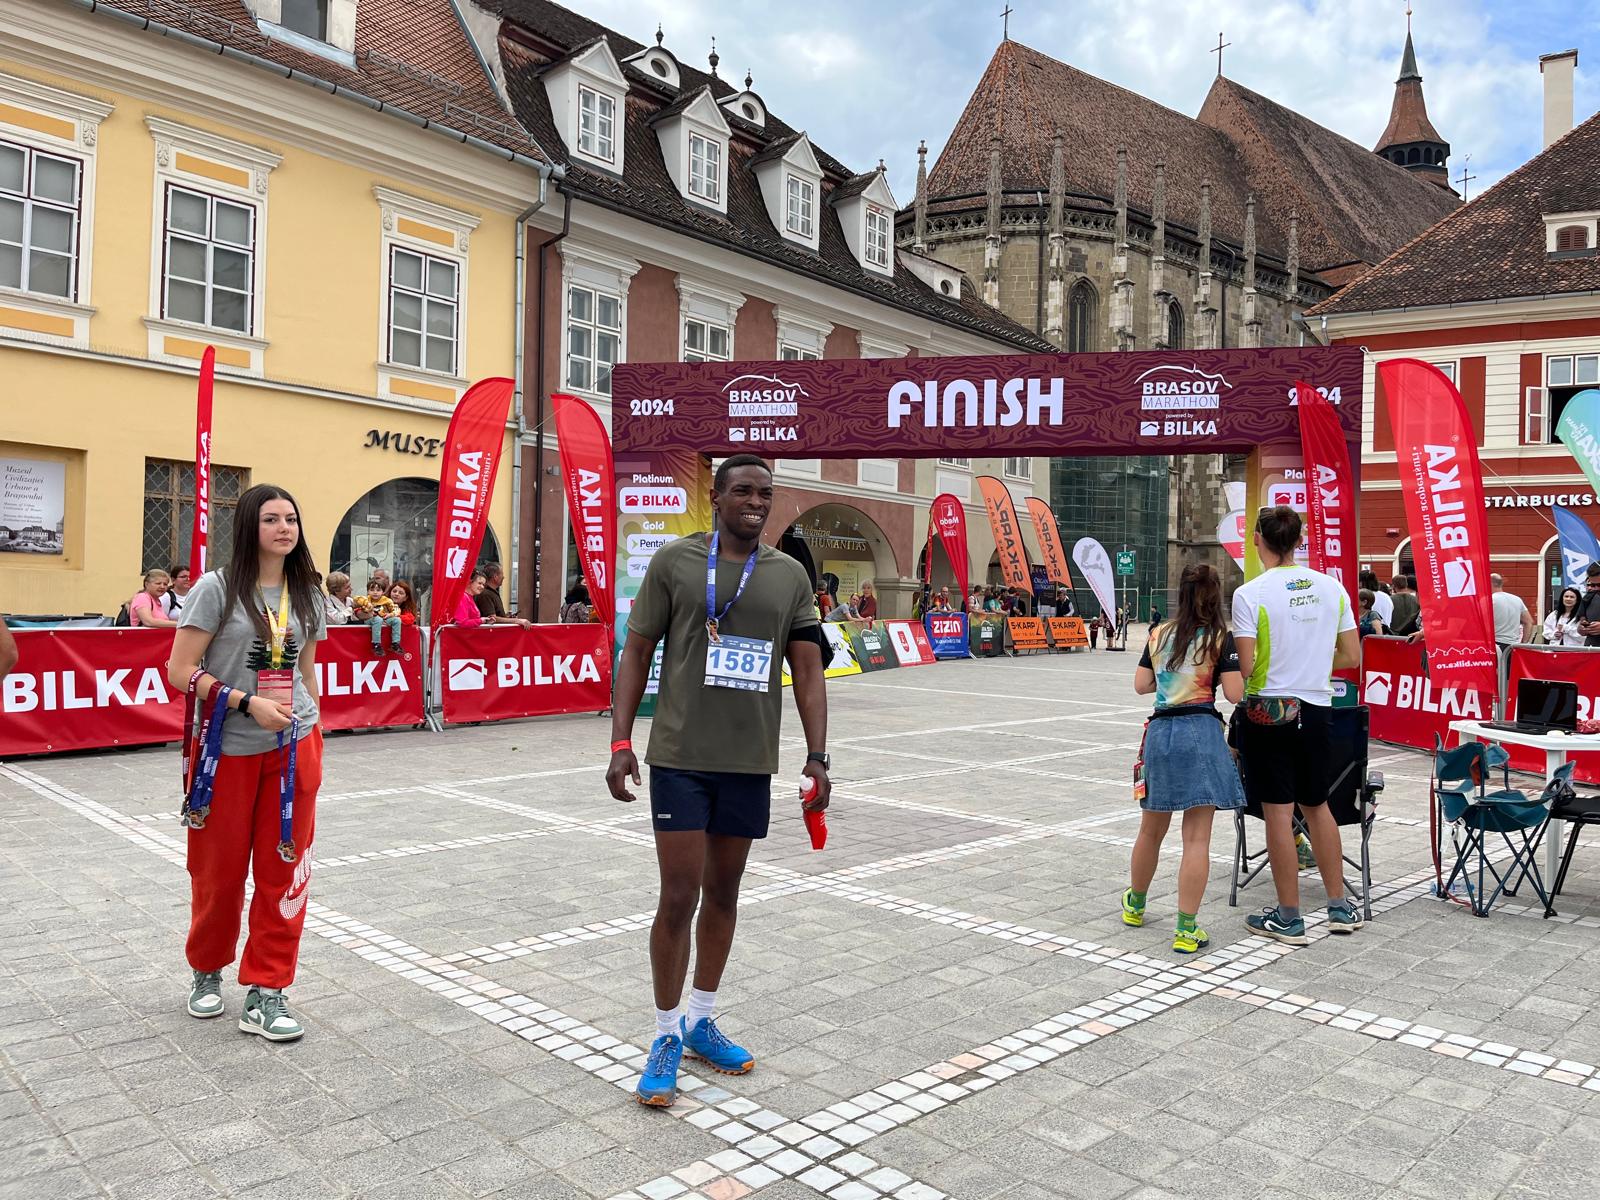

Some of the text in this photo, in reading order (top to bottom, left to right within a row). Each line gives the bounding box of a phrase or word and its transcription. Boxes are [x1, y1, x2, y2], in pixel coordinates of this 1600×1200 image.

[1142, 380, 1219, 394] BRASOV
[729, 389, 797, 402] BRASOV
[1142, 395, 1219, 409] MARATHON
[629, 399, 675, 416] 2024
[729, 403, 797, 416] MARATHON
[887, 377, 1065, 429] FINISH
[750, 427, 798, 441] BILKA
[1163, 421, 1218, 436] BILKA
[364, 429, 446, 457] MUSE
[632, 474, 674, 484] Platinum
[450, 451, 483, 540] BILKA
[642, 495, 680, 506] BILKA
[1484, 494, 1592, 508] STARBUCKS
[643, 521, 665, 530] Gold
[811, 537, 867, 551] HUMANITAS
[709, 648, 770, 674] 1587
[497, 654, 600, 688] BILKA
[313, 660, 410, 697] ILKA
[2, 667, 170, 713] BILKA
[1396, 674, 1483, 720] BILKA
